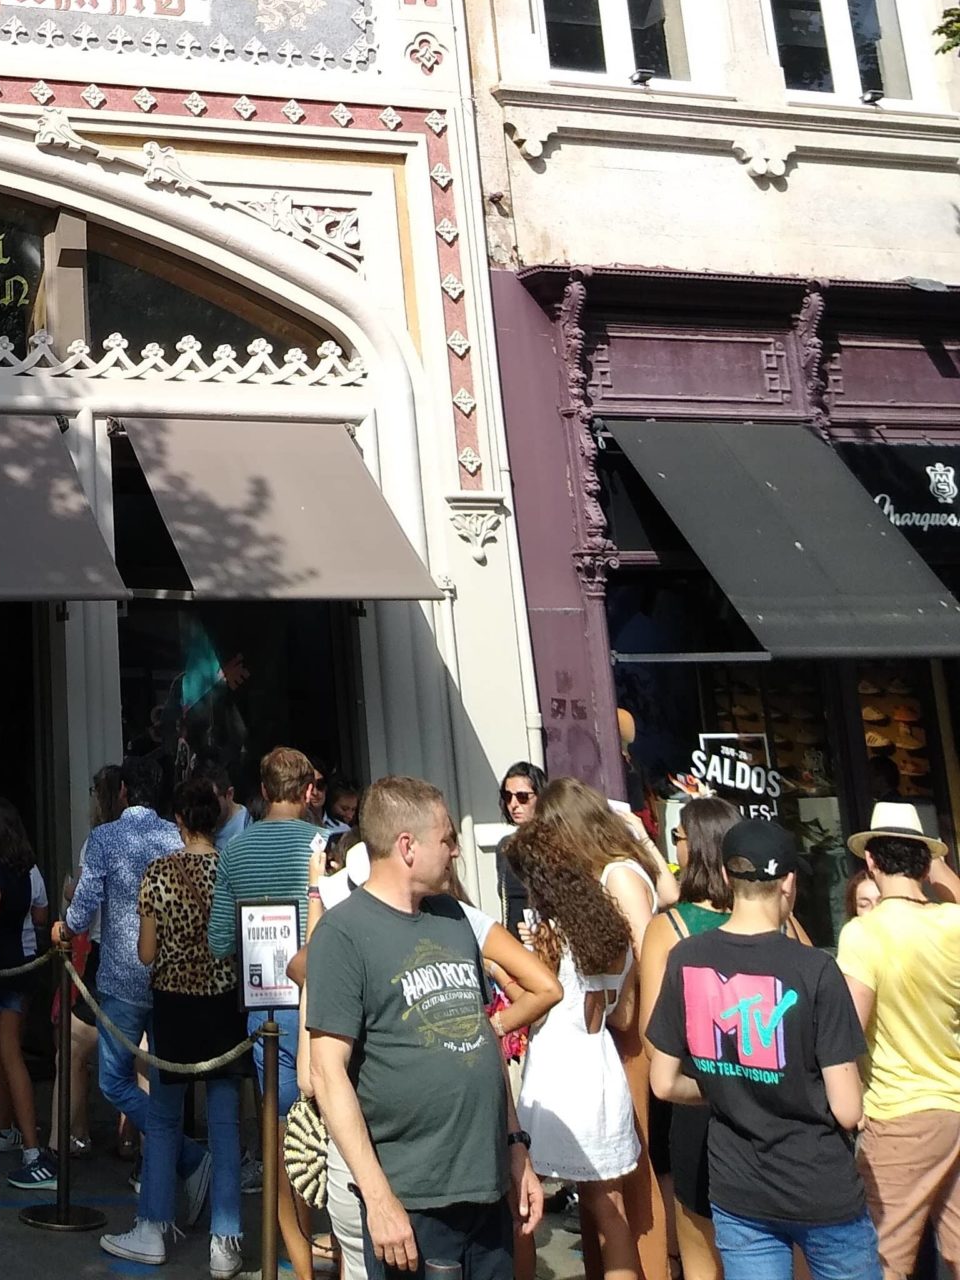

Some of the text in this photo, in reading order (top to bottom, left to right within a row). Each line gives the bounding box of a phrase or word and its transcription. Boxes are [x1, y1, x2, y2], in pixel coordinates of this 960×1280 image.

[690, 749, 782, 797] SALDOS
[247, 926, 277, 940] VOUCHER
[401, 961, 480, 1006] HARD ROCK
[682, 965, 798, 1070] MTV
